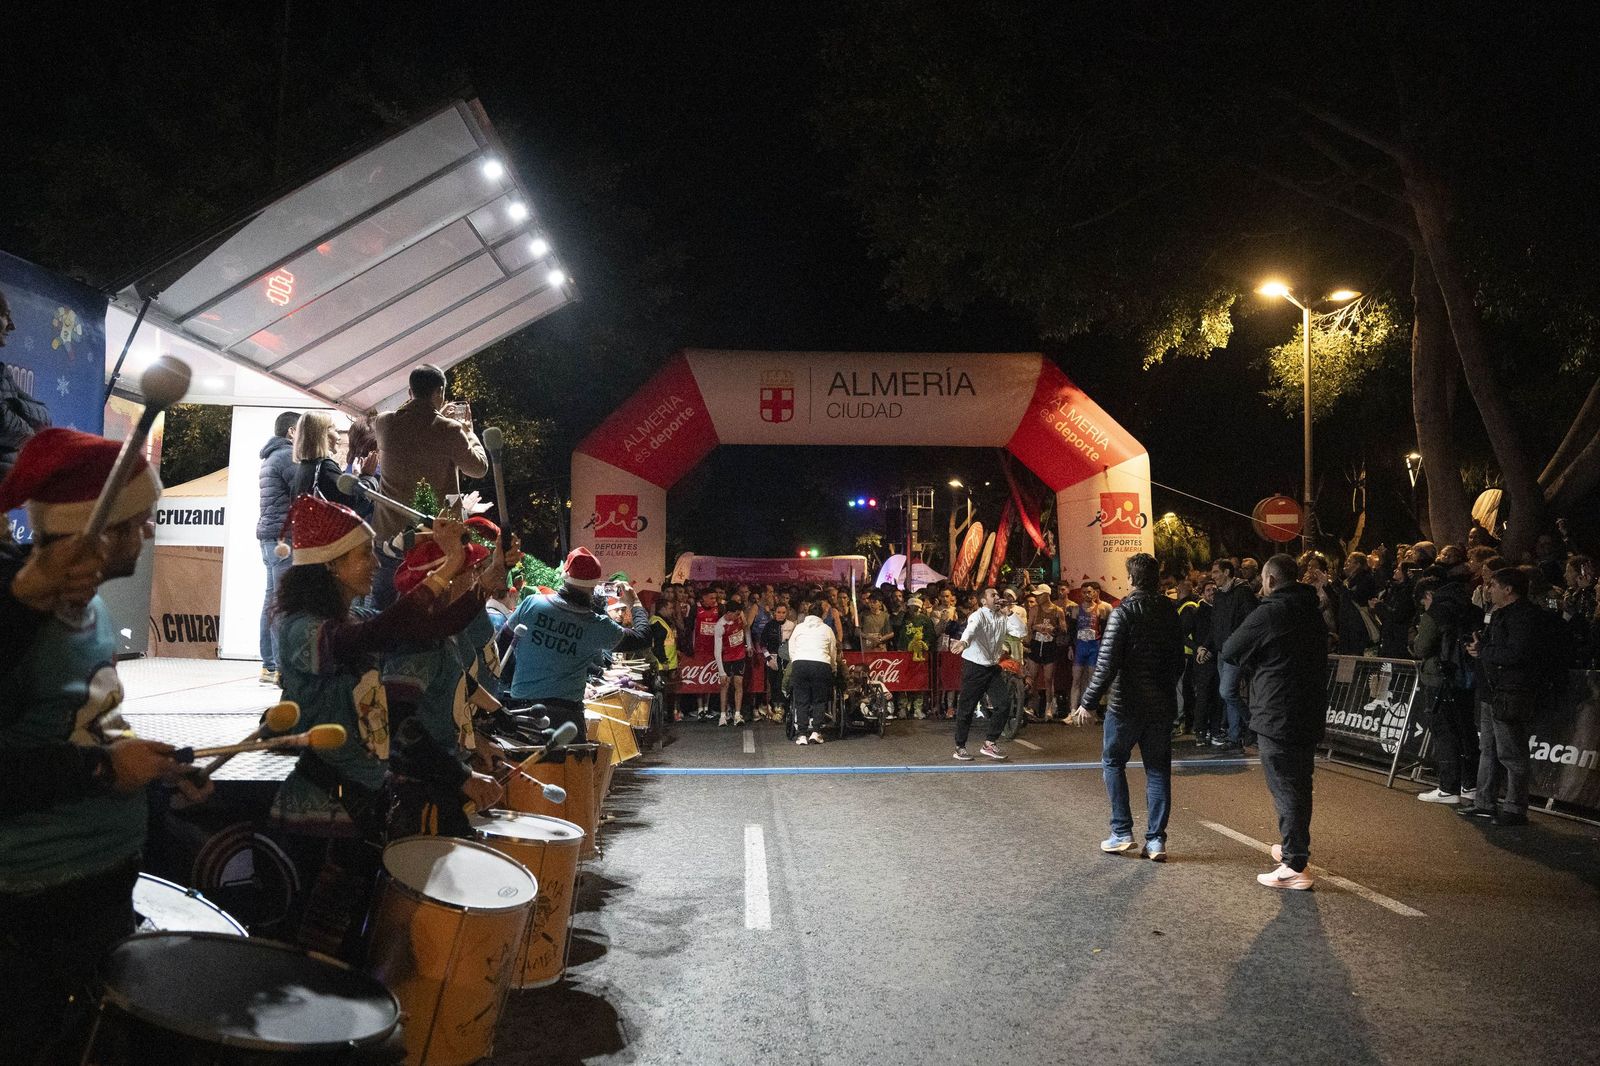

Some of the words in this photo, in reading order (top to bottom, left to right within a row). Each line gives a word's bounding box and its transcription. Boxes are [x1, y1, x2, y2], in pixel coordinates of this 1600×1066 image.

[827, 367, 976, 396] ALMERÍA
[826, 402, 903, 419] CIUDAD
[635, 447, 651, 463] es
[650, 406, 695, 450] deporte
[1040, 408, 1055, 423] es
[1054, 421, 1100, 462] deporte
[595, 543, 638, 551] DEPORTES
[1102, 539, 1143, 547] DEPORTES
[534, 612, 584, 640] BLOCO
[532, 629, 578, 656] SUCA
